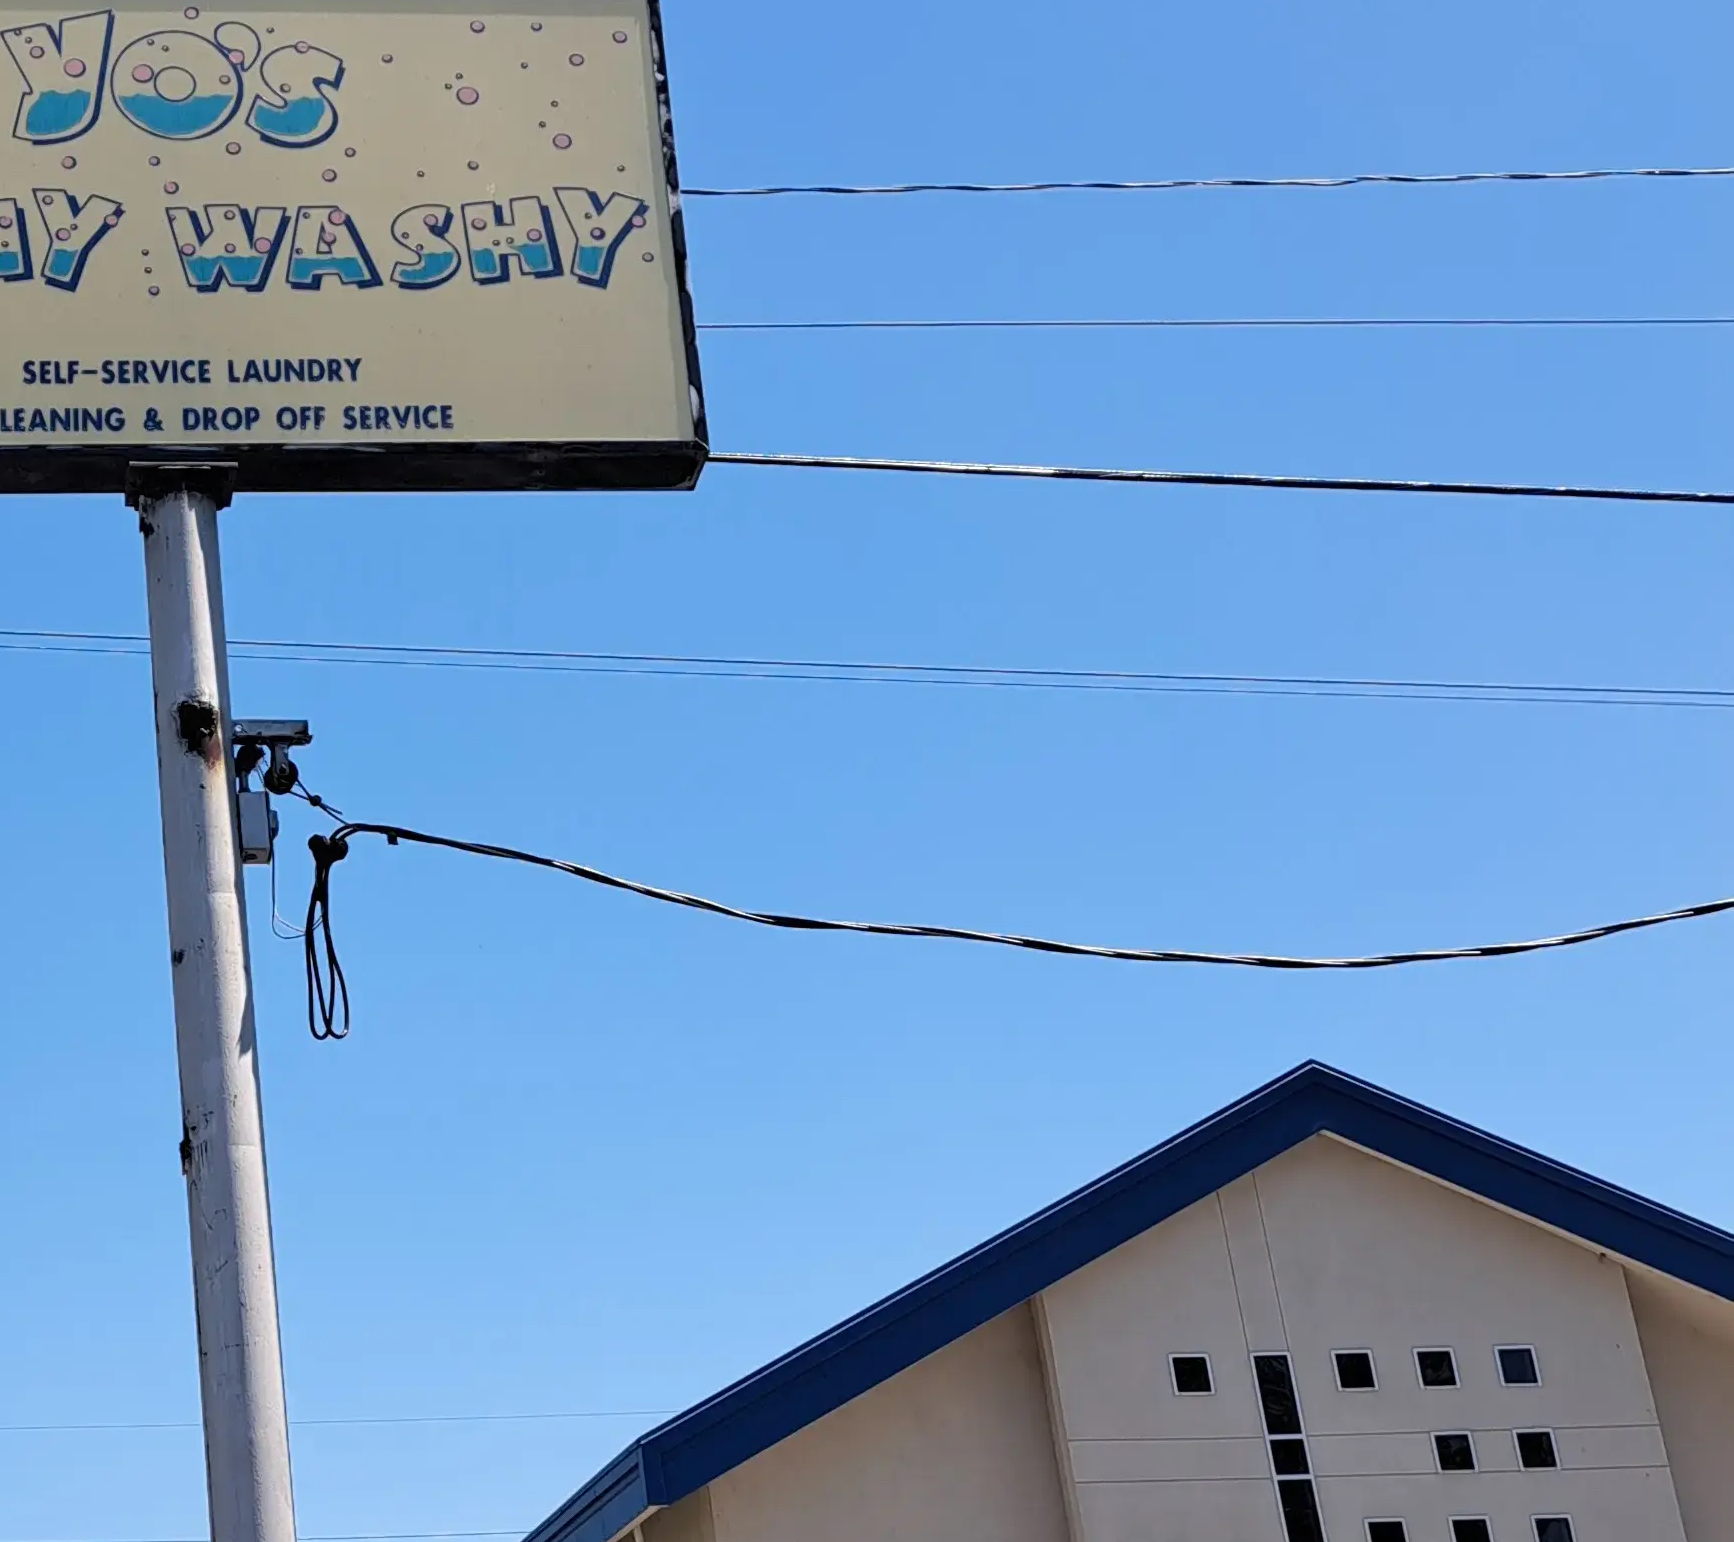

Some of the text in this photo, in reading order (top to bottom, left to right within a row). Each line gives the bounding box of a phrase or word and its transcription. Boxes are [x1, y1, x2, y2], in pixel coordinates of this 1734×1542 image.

[0, 9, 346, 149] YO'S
[166, 187, 650, 291] WASHY
[21, 358, 363, 385] SELF-SERVICE LAUNDRY
[142, 407, 164, 432] &
[181, 406, 261, 431] DROP
[275, 406, 327, 431] OFF
[342, 404, 455, 430] SERVICE
